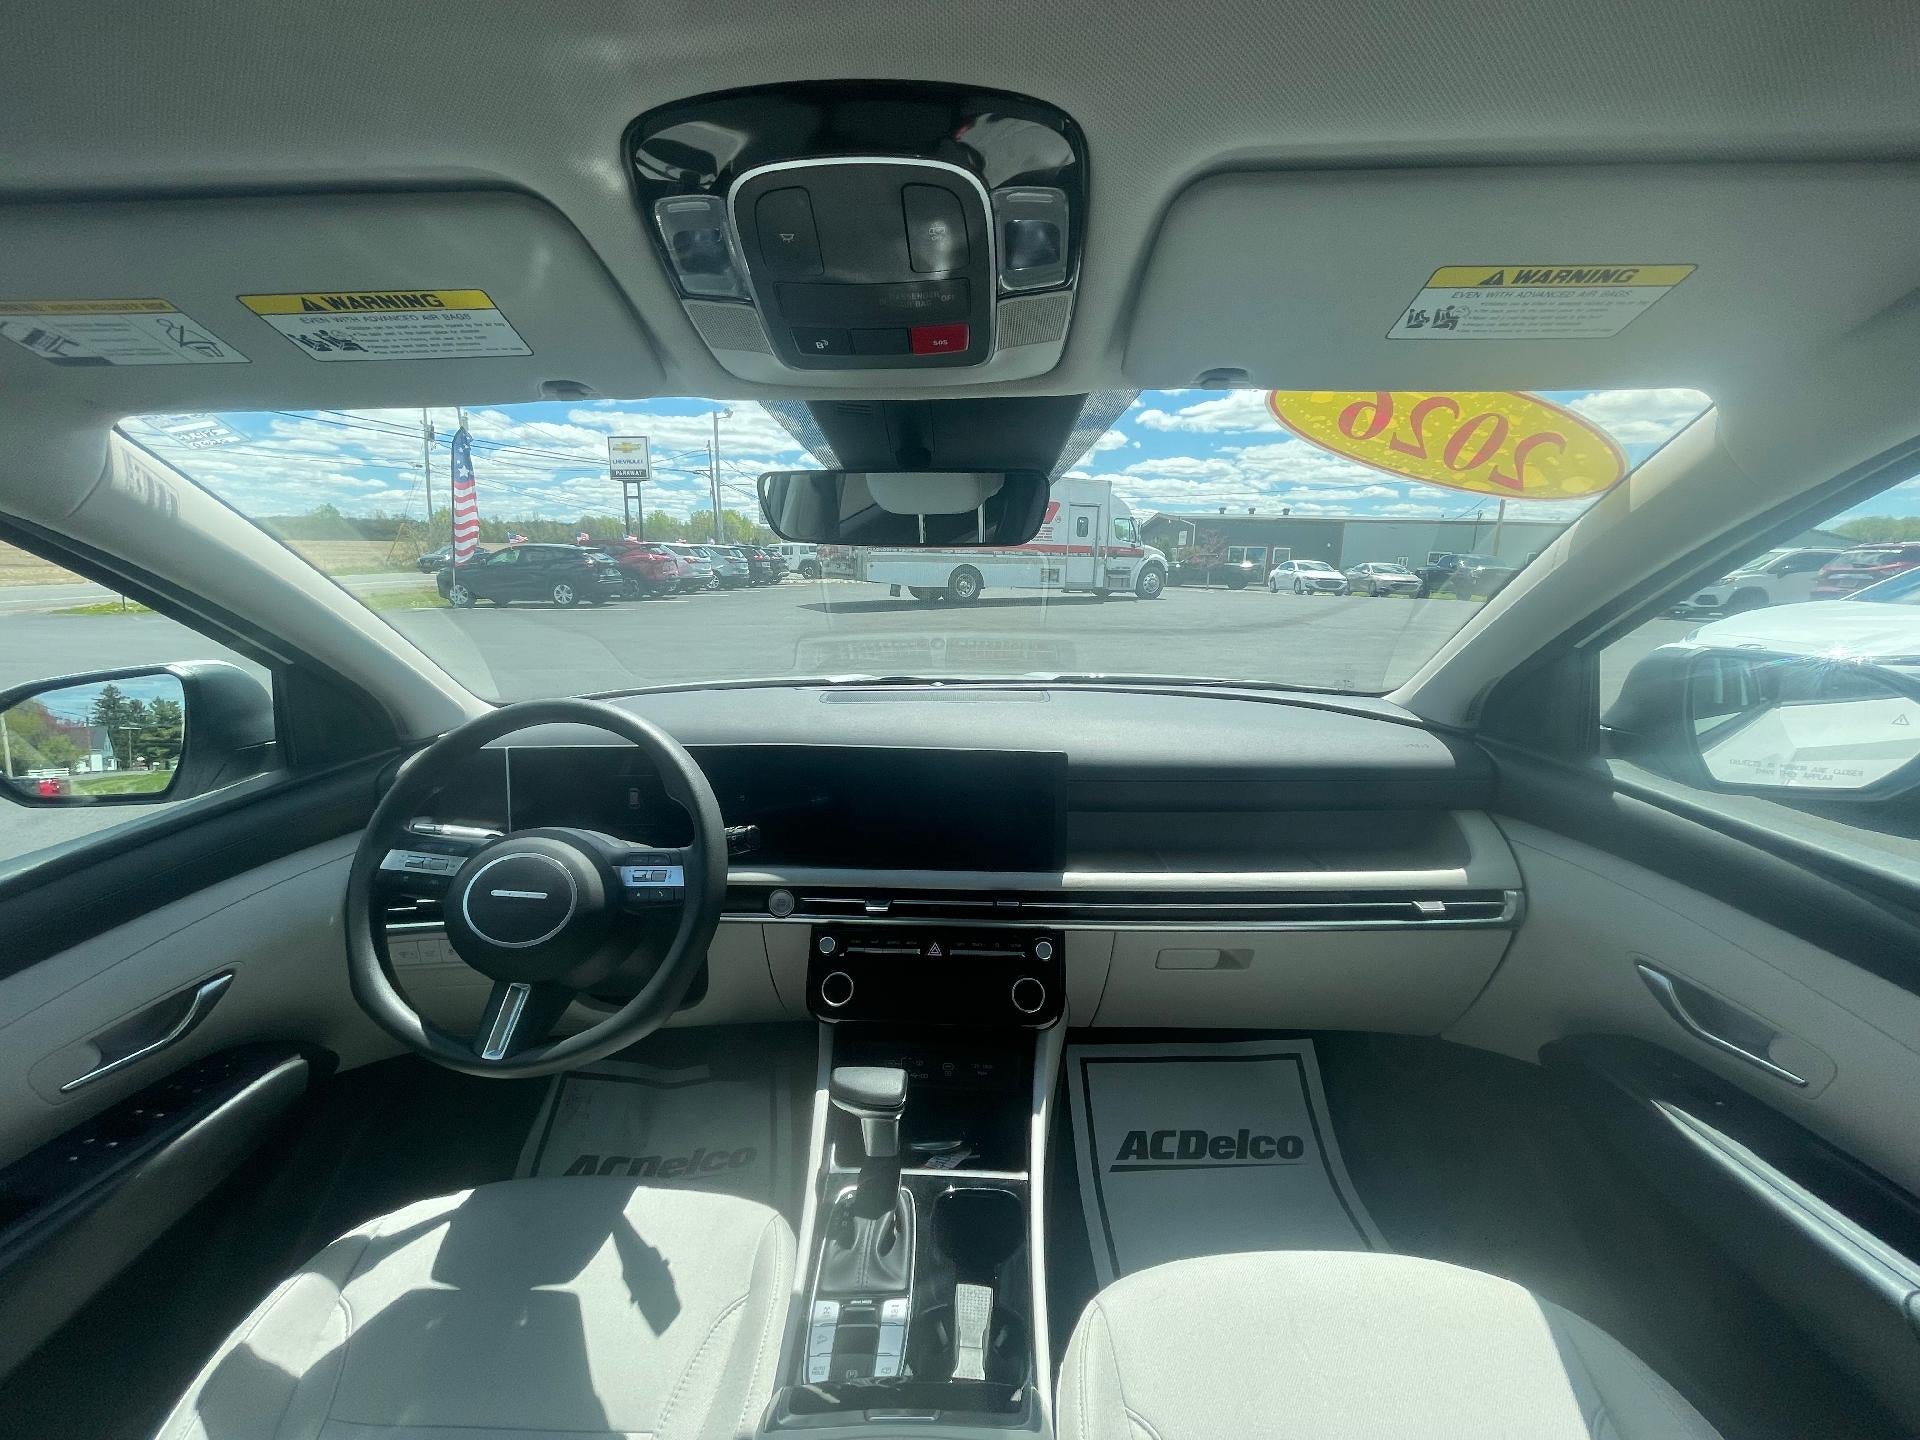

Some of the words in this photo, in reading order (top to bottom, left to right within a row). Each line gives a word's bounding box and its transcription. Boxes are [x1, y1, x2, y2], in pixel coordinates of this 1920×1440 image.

[1510, 268, 1640, 285] WARNING
[324, 292, 446, 311] WARNING
[1450, 290, 1482, 299] EVEN
[1484, 290, 1514, 299] WITH
[1515, 289, 1575, 298] ADVANCED
[299, 316, 331, 325] EVEN
[332, 315, 361, 324] WITH
[362, 314, 419, 323] ADVANCED
[1115, 1128, 1304, 1161] ACDelco
[563, 1146, 758, 1177] ACDelco
